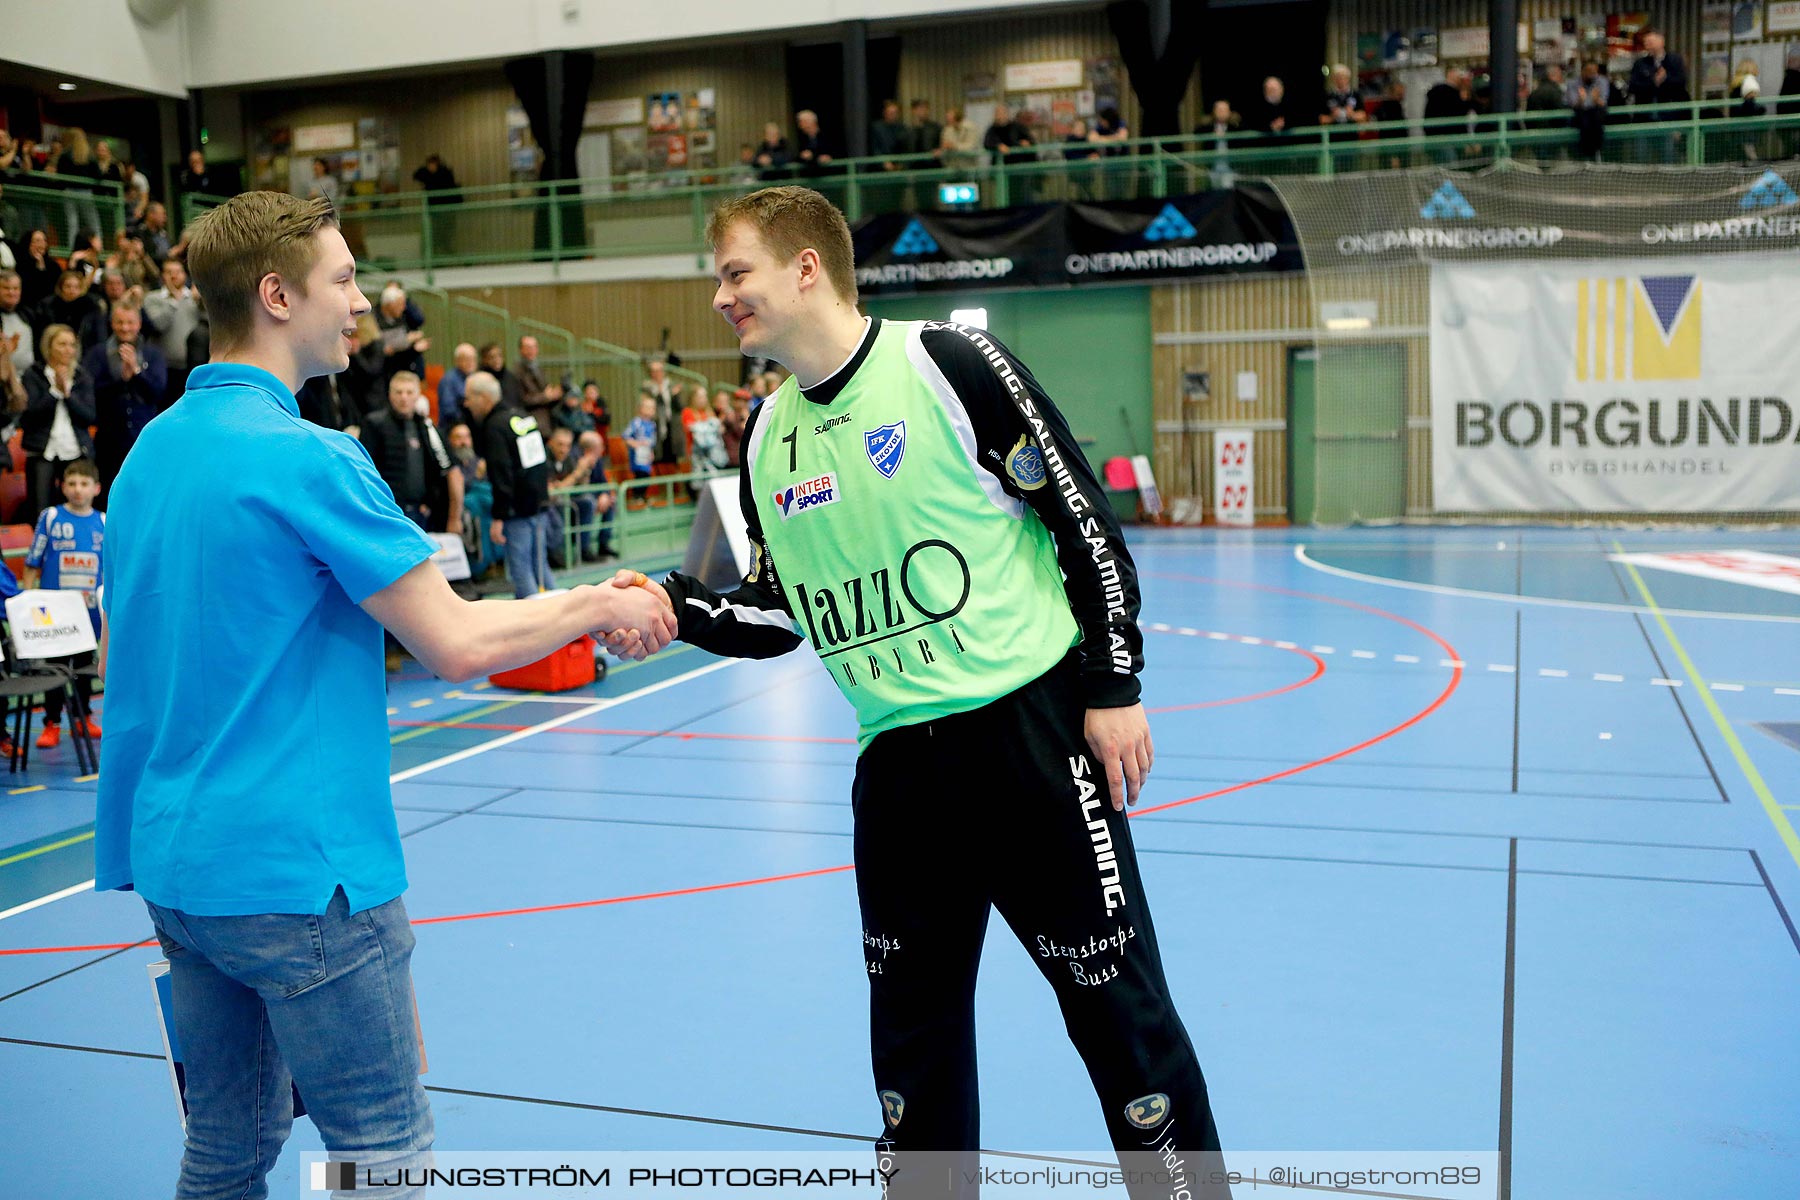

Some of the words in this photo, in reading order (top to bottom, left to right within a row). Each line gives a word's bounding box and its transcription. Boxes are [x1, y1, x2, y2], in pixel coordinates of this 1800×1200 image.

[1336, 225, 1564, 256] ONEPARTNERGROUP
[857, 257, 1014, 285] PARTNERGROUP
[1065, 242, 1277, 275] ONEPARTNERGROUP
[1456, 397, 1800, 448] BORGUND
[782, 425, 798, 473] 1
[1550, 457, 1731, 476] BYGGHANDEL
[795, 476, 832, 498] INTER
[797, 488, 833, 510] SPORT
[51, 521, 75, 540] 40
[1069, 754, 1126, 917] SALMING.
[1037, 925, 1136, 959] Stenstorps
[1069, 961, 1119, 986] Buss
